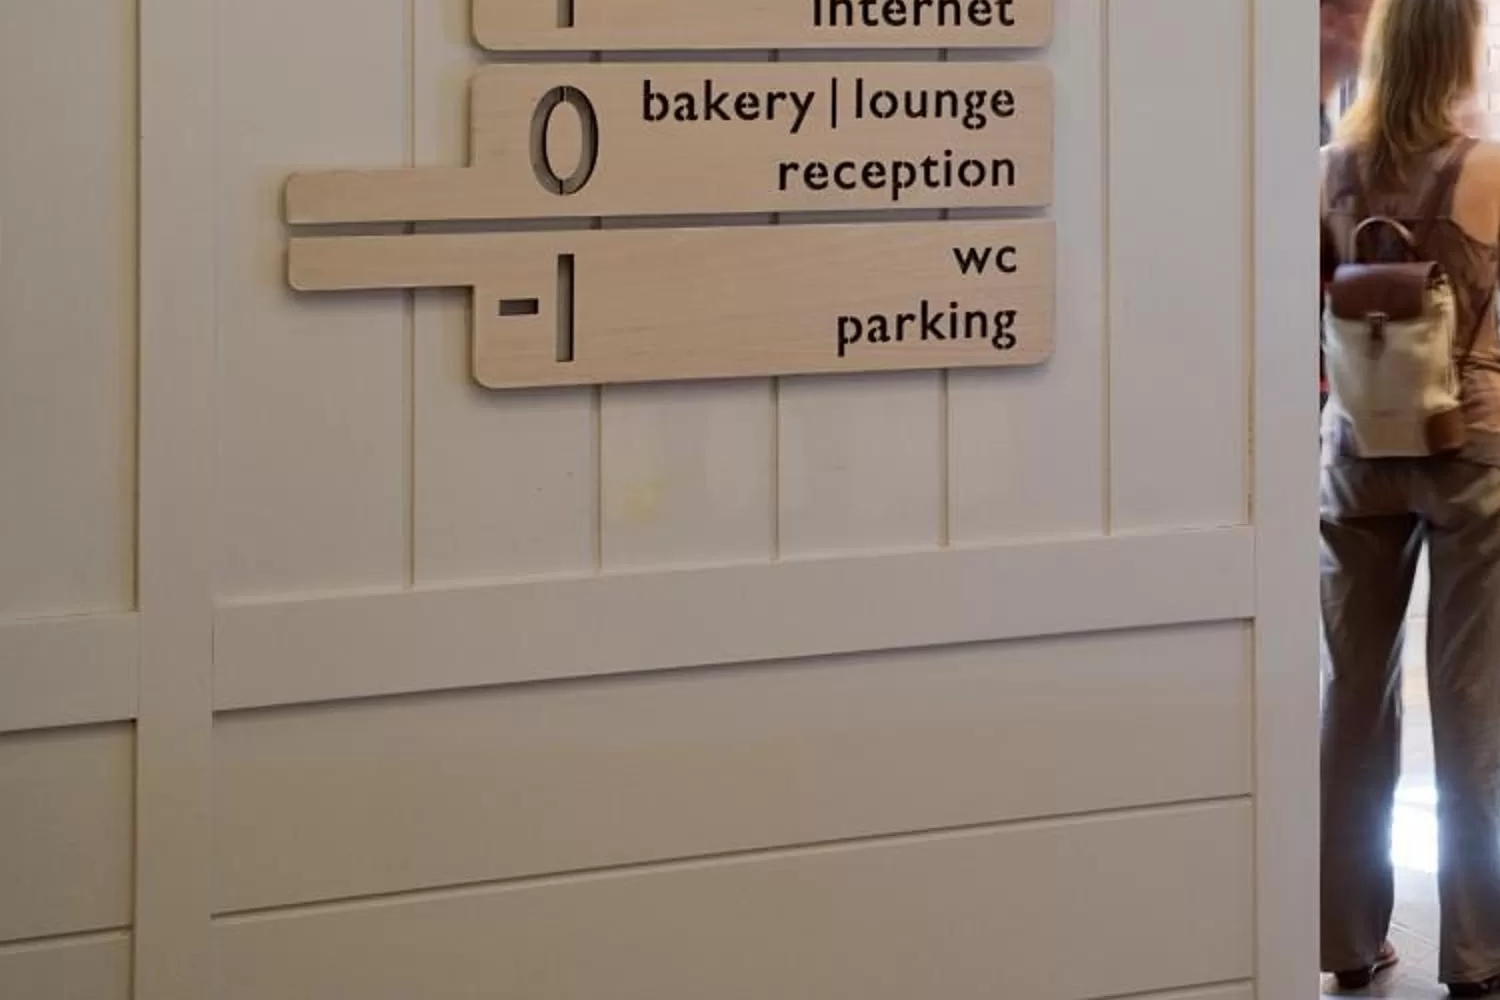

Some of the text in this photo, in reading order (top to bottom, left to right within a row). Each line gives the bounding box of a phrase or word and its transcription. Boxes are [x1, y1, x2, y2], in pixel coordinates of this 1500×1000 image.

[641, 78, 816, 134] bakery
[854, 77, 1016, 131] lounge
[529, 84, 599, 196] 0
[778, 149, 1017, 202] reception
[952, 244, 1018, 275] wc
[836, 299, 1018, 358] parking
